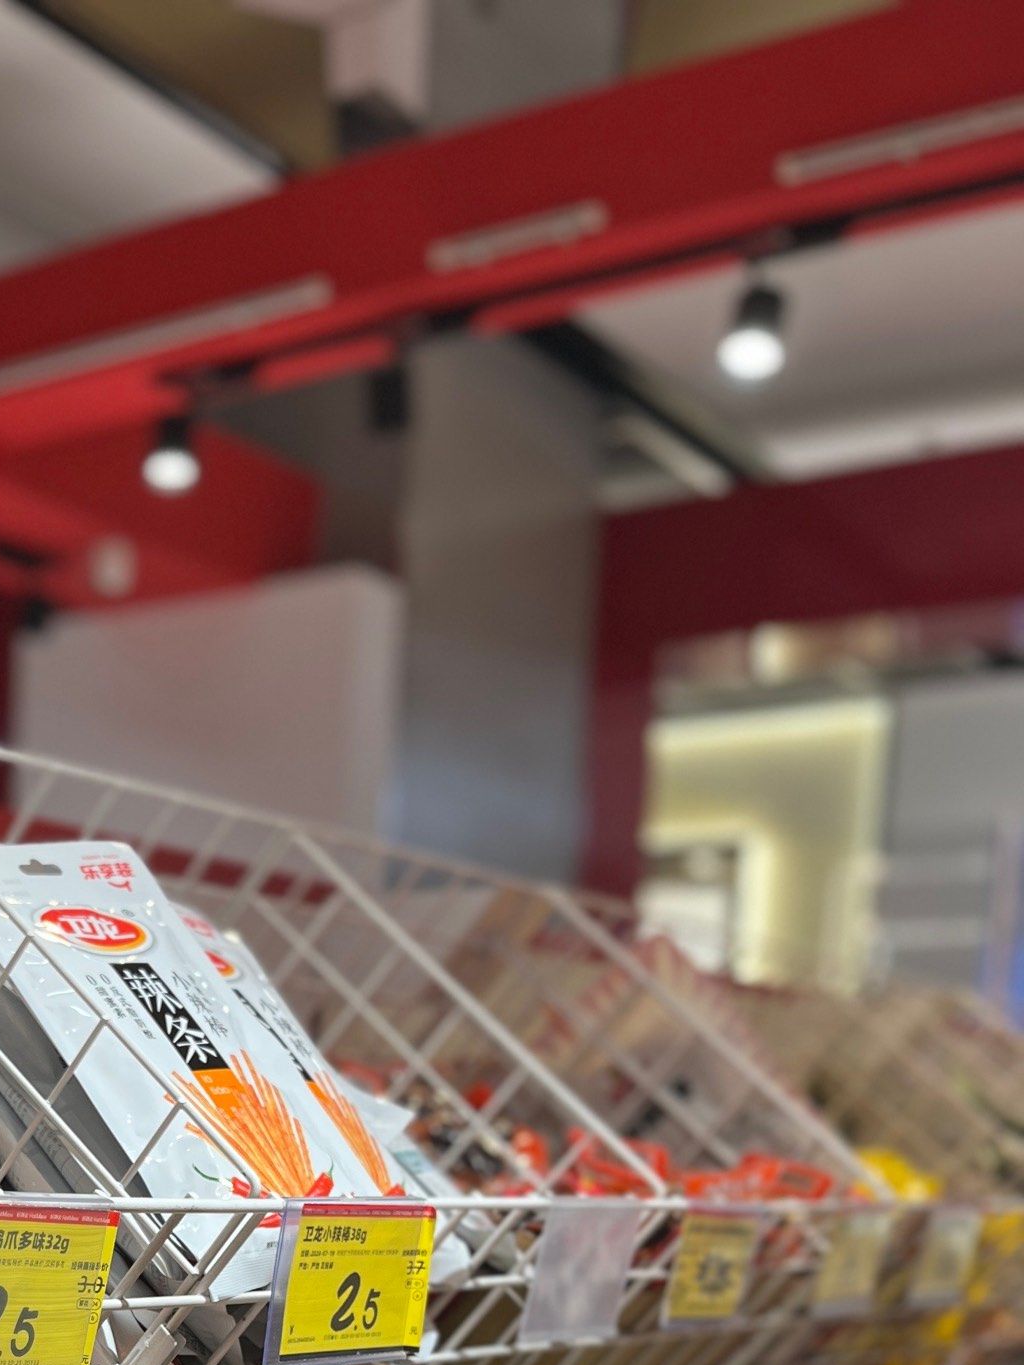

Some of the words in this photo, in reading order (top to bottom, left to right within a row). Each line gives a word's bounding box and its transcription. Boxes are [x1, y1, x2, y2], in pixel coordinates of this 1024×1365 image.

[59, 915, 137, 941] 卫龙
[122, 968, 218, 1065] 辣条
[303, 1226, 368, 1244] 卫龙小辣棒38g
[330, 1271, 381, 1333] 2.5
